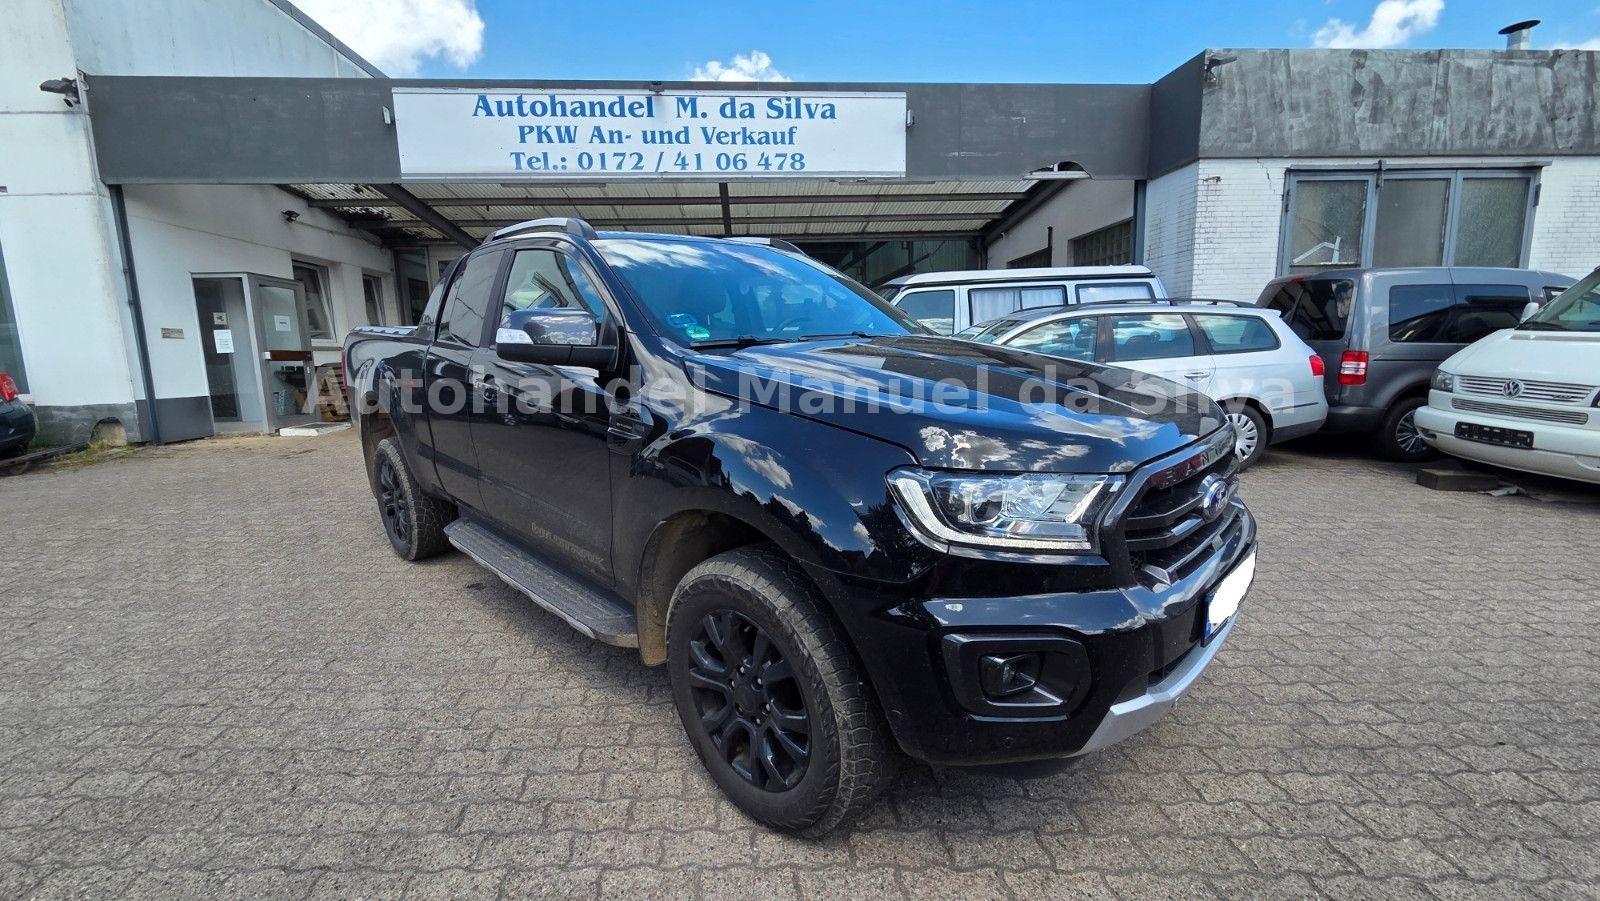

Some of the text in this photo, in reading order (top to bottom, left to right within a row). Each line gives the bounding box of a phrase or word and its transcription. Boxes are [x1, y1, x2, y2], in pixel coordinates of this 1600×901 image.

[472, 94, 837, 120] Autohandel M. da Silva
[518, 125, 798, 146] PKW An- und Verkauf
[510, 151, 568, 171] Tel.:
[576, 151, 645, 171] 0172
[674, 151, 704, 171] 41
[715, 152, 748, 172] 06
[756, 152, 806, 172] 478
